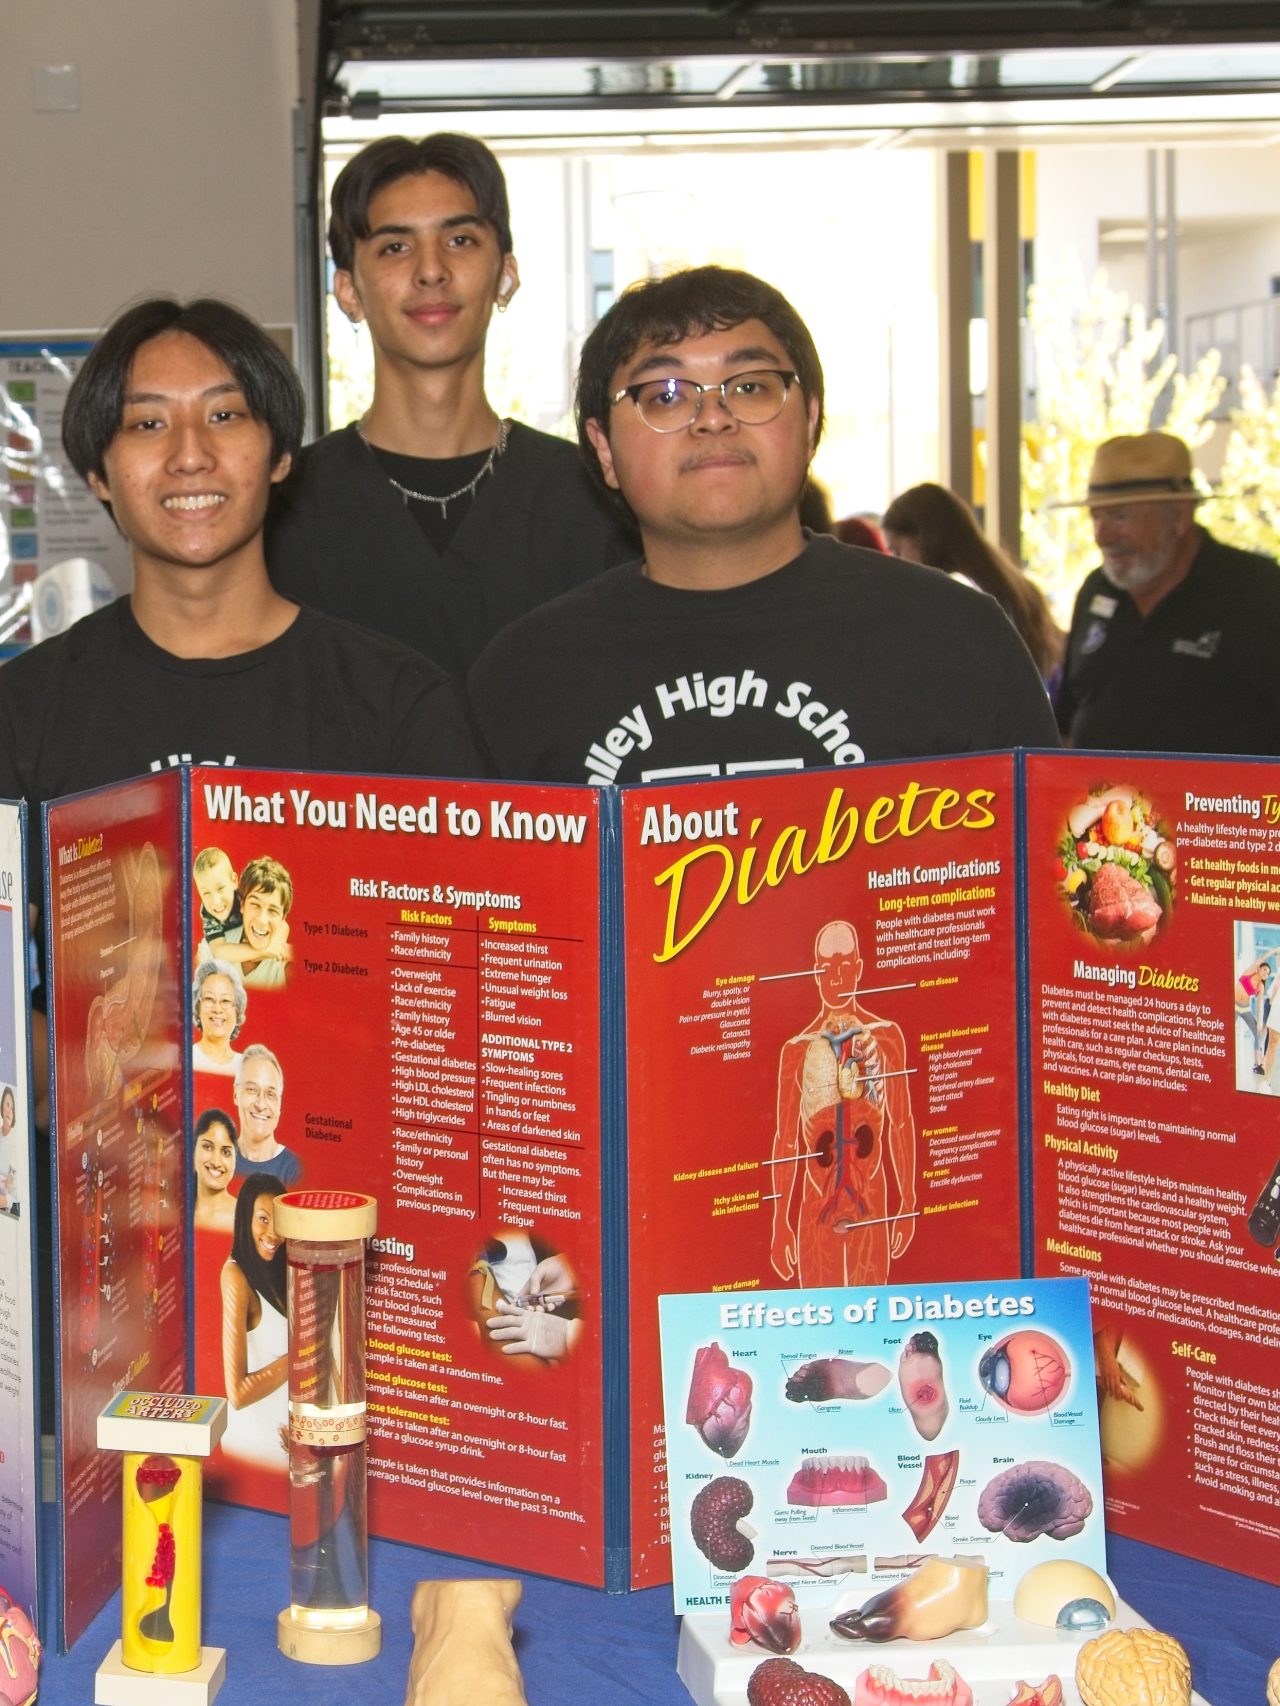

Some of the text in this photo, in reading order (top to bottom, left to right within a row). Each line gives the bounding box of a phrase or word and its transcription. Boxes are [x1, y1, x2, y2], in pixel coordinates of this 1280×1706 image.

[655, 669, 768, 719] High
[203, 784, 587, 844] What You Need to Know
[1185, 792, 1260, 819] Preventing
[640, 801, 739, 846] About
[653, 781, 995, 963] Diabetes
[868, 858, 1000, 890] Health Complications
[350, 878, 521, 910] Risk Factors & Symptoms
[879, 886, 995, 912] Long-term complications
[401, 910, 453, 926] Risk Factors
[489, 917, 537, 933] Symptoms
[304, 922, 368, 938] Type 1 Diabetes
[1074, 961, 1199, 992] Managing Diabetes
[482, 1032, 573, 1053] ADDITIONAL TYPE 2
[482, 1047, 534, 1063] SYMPTOMS
[1044, 1081, 1100, 1101] Healthy Diet
[1045, 1135, 1118, 1163] Physical Activity
[1047, 1238, 1102, 1263] Medications
[720, 1294, 1035, 1329] Effects of Diabetes
[883, 1337, 902, 1345] Foot
[978, 1334, 993, 1342] Eye
[1171, 1341, 1217, 1365] Self-Care
[126, 1406, 198, 1418] ARTERY
[130, 1396, 202, 1409] OCCLUDED
[801, 1447, 828, 1455] Mouth
[898, 1454, 920, 1462] Blood
[993, 1456, 1014, 1464] Brain
[686, 1472, 713, 1481] Kidney
[686, 1596, 722, 1607] HEALTH
